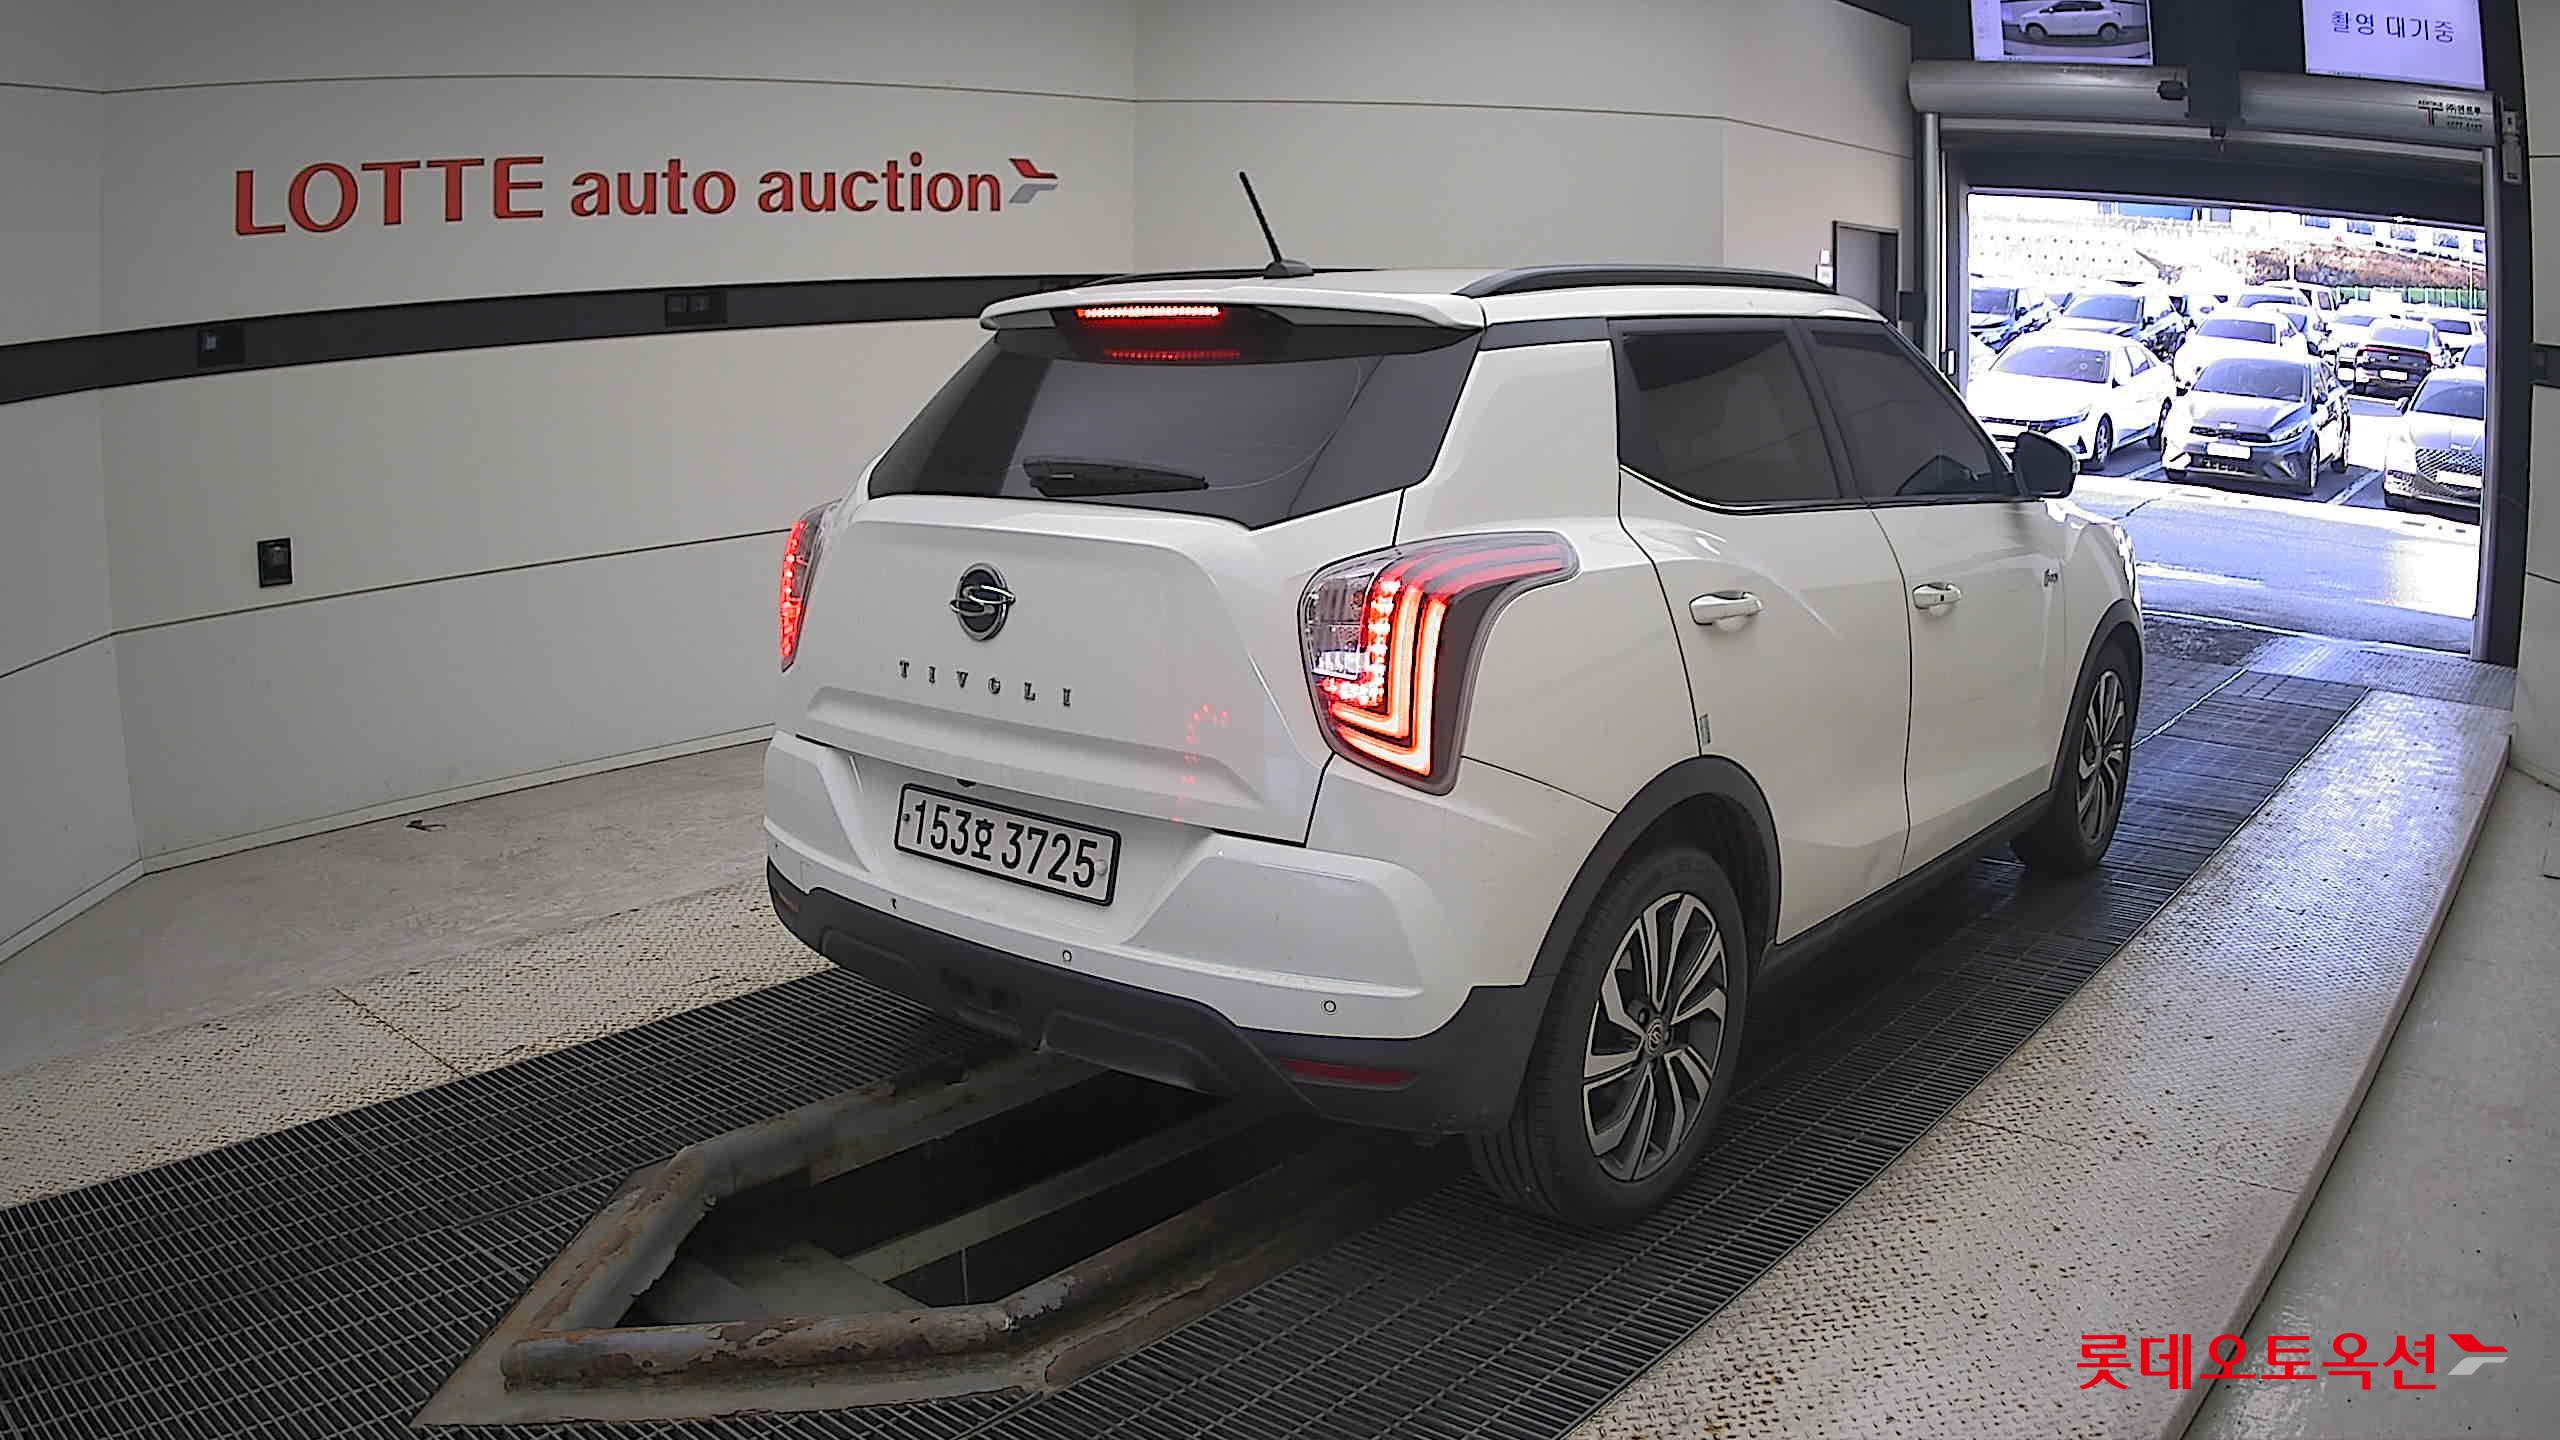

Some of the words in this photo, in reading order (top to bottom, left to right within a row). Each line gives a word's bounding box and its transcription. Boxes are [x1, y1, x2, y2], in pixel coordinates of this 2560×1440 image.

[2386, 16, 2455, 44] 대기중
[236, 156, 544, 236] LOTTE
[570, 158, 736, 217] auto
[758, 151, 1002, 213] auction
[899, 660, 1072, 708] TIVOLI
[914, 799, 995, 862] 153호
[1001, 821, 1099, 889] 3725
